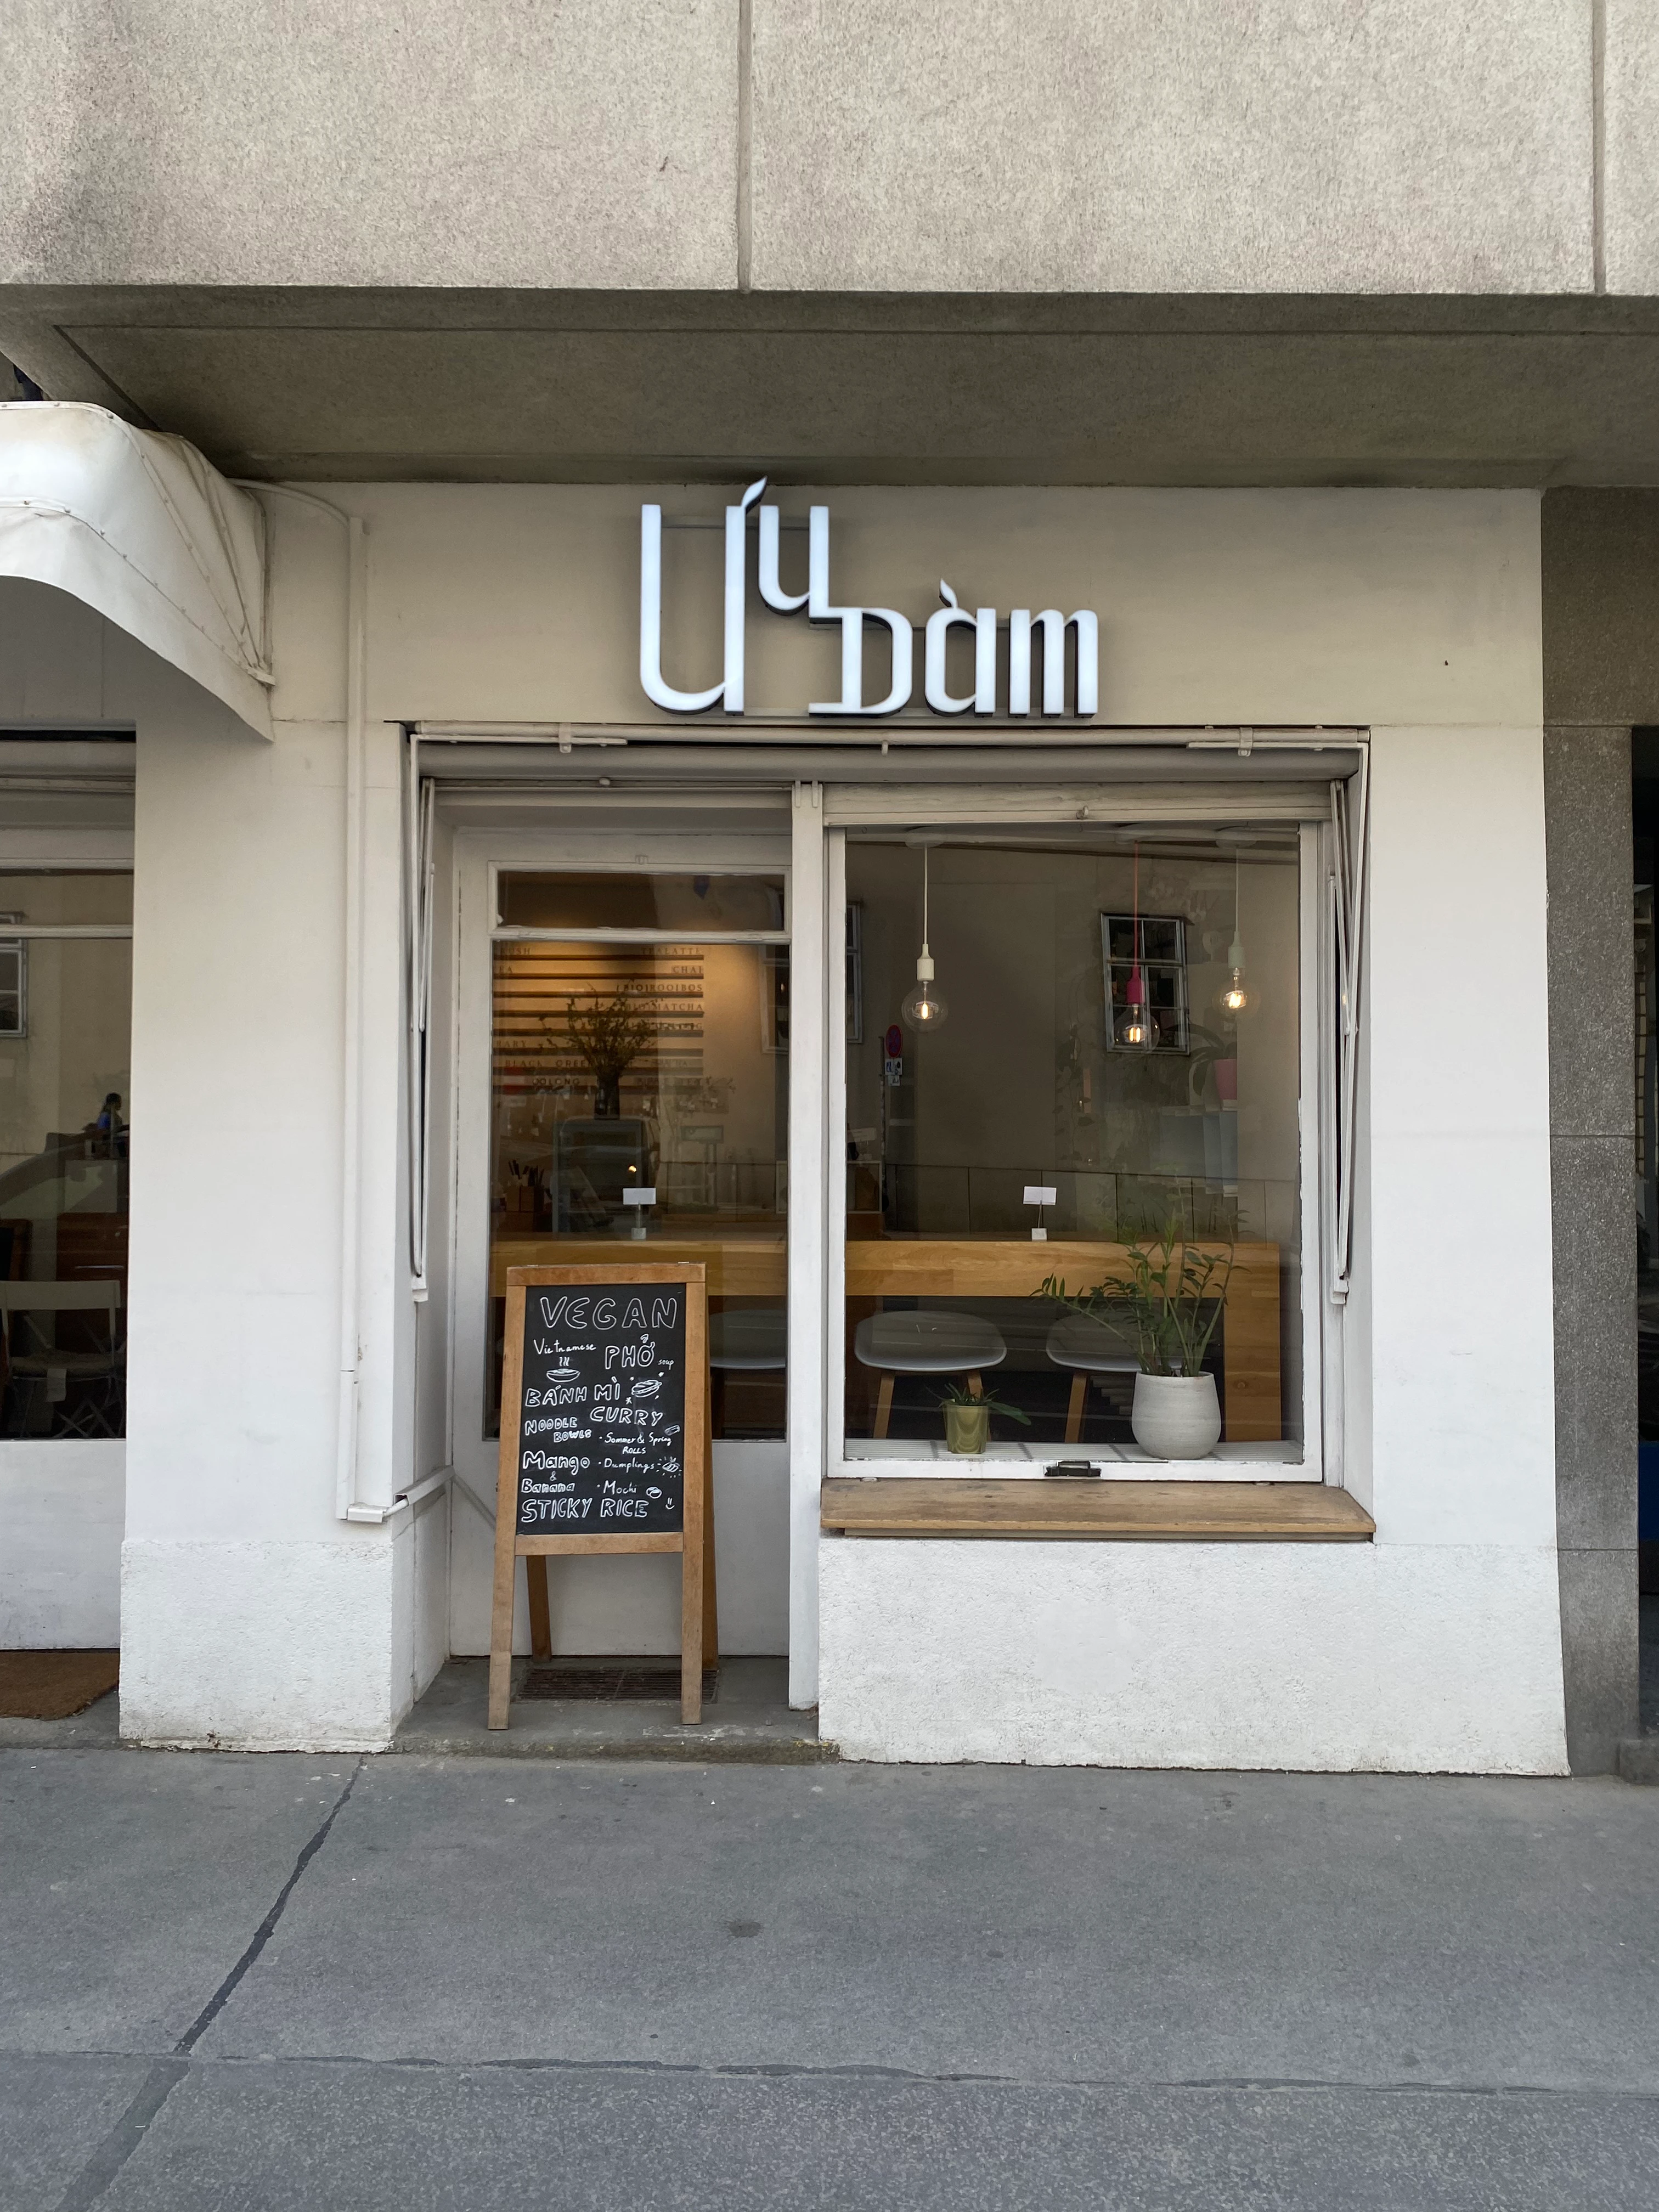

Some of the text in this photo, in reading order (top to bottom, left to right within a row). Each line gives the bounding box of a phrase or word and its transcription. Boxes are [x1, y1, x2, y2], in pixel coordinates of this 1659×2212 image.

[540, 1296, 677, 1330] VEGAN
[533, 1338, 596, 1355] Vietnamese
[658, 1359, 674, 1370] soup
[590, 1406, 663, 1426] CURRY
[524, 1417, 578, 1436] NOODLE
[554, 1429, 592, 1443] BOWLS
[637, 1435, 645, 1444] &
[648, 1432, 672, 1446] Spring
[622, 1446, 646, 1454] ROLLS
[522, 1450, 590, 1476] Mango
[604, 1457, 654, 1473] Dumplings
[550, 1471, 557, 1481] &
[521, 1478, 575, 1493] Banana
[603, 1480, 637, 1495] Mochi
[521, 1498, 649, 1523] STICKY RICE
